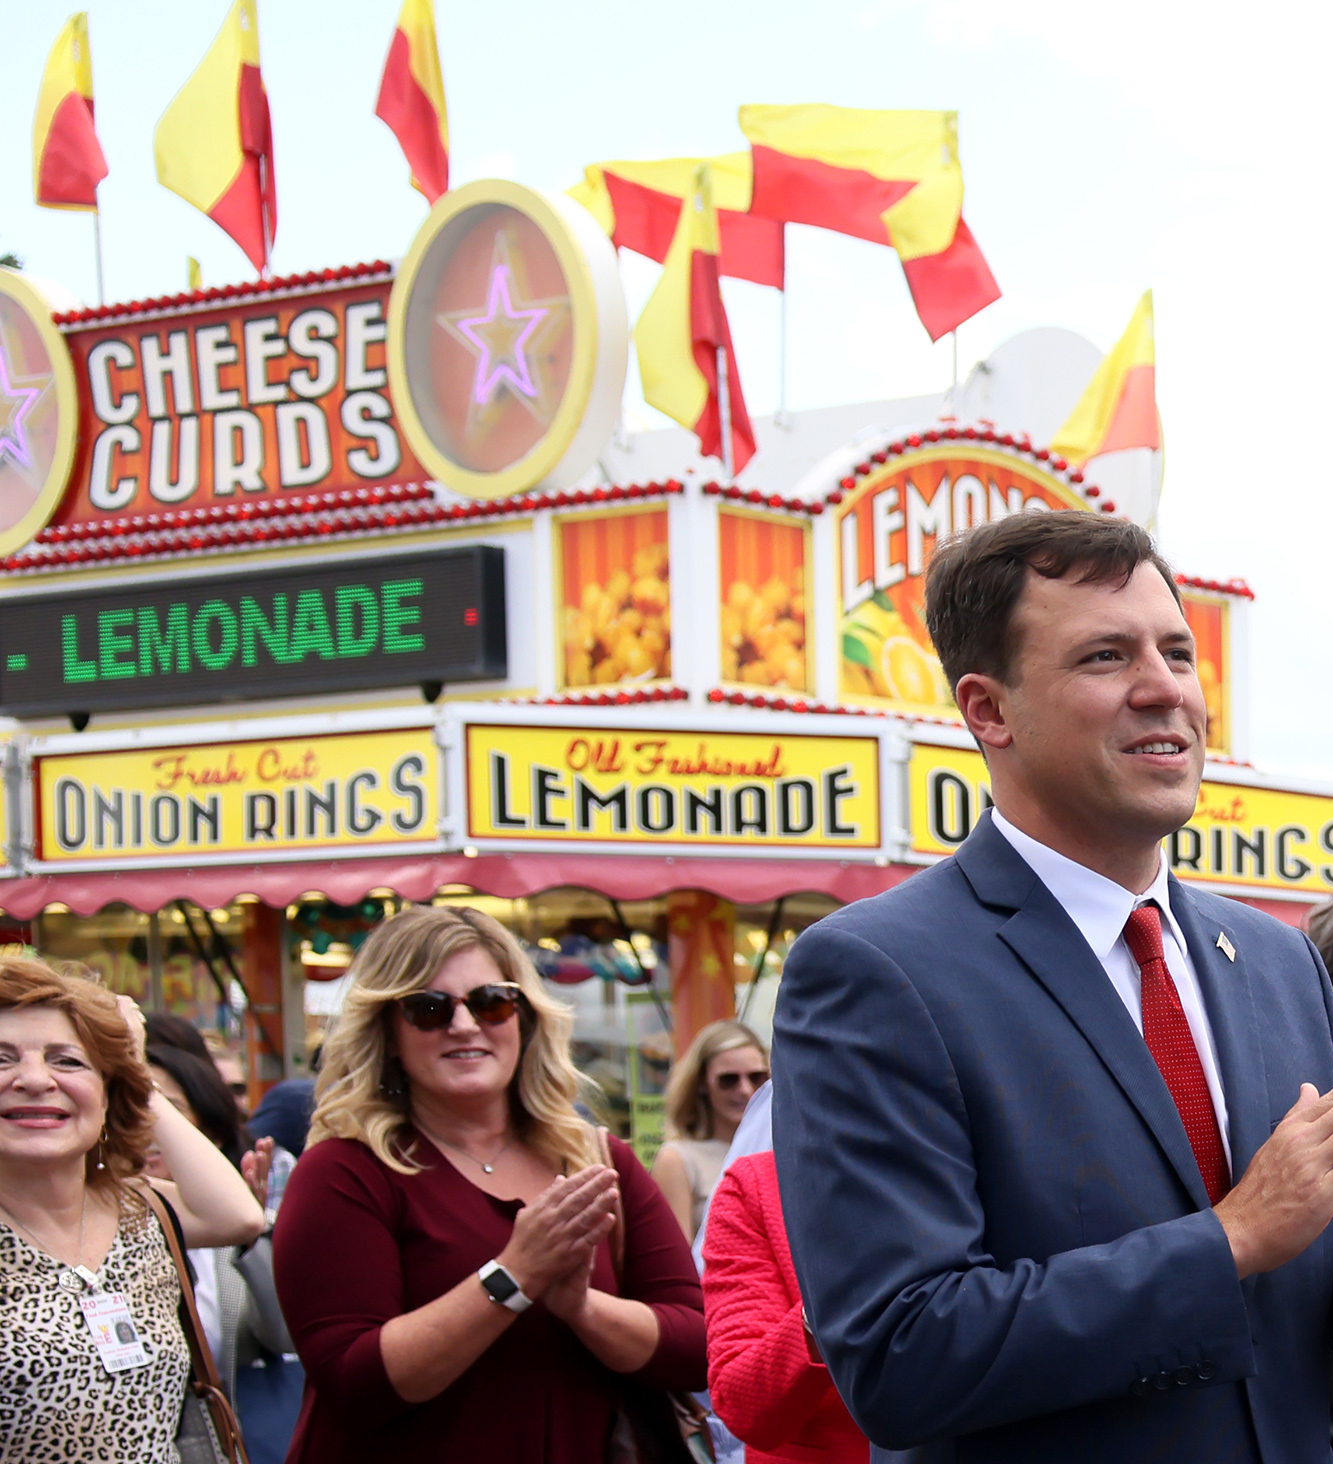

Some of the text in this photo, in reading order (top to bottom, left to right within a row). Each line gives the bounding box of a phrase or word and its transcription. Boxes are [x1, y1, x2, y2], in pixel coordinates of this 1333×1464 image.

[87, 300, 388, 425] CHEESE
[88, 390, 401, 511] CURDS
[61, 578, 426, 684] LEMONADE
[56, 753, 427, 852] ONION RINGS
[153, 747, 319, 791] Fresh Cut
[489, 750, 858, 838] LEMONADE
[566, 738, 785, 778] Old Fashioned
